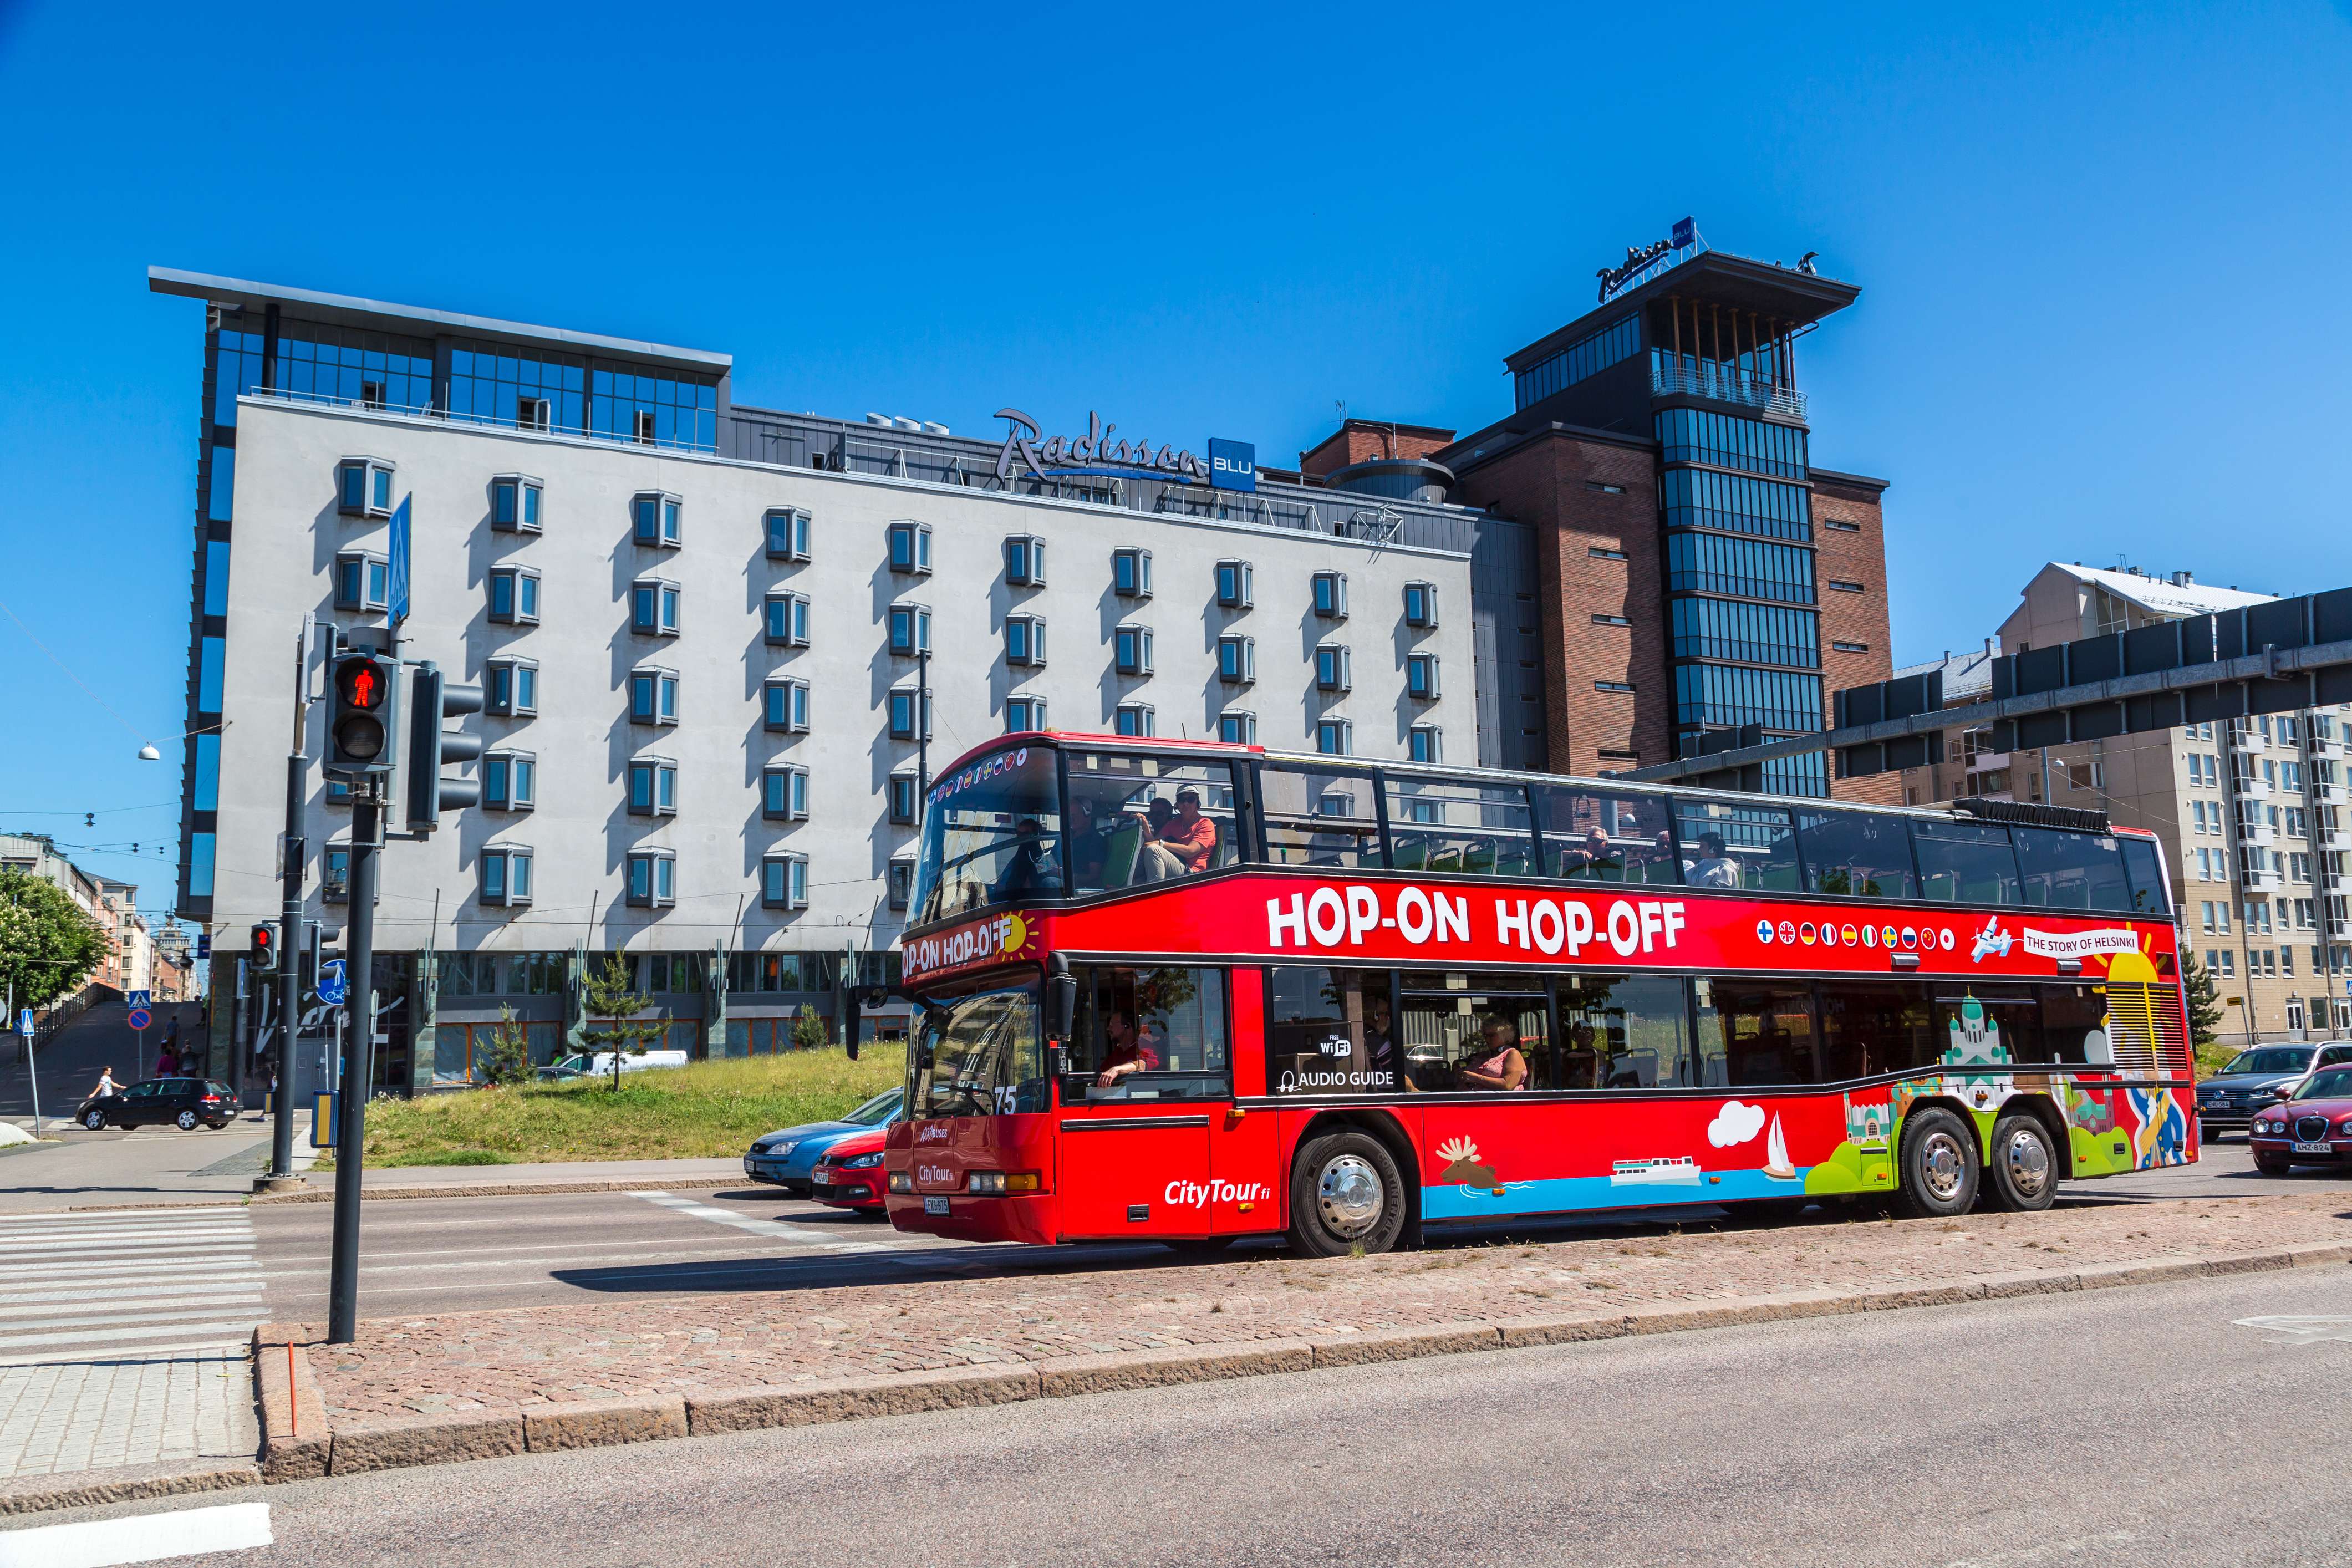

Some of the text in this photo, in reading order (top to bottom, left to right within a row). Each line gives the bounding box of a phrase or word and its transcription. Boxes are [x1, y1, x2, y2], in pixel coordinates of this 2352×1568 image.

[1674, 226, 1690, 241] BLU
[993, 408, 1206, 484] Radisson
[1214, 457, 1251, 475] BLU
[1267, 886, 1686, 956] HOP-ON HOP-OFF
[902, 918, 1012, 978] OP-ON HOP-OFF
[2027, 936, 2135, 952] THE STORY OF HELSINKI
[1298, 1071, 1394, 1086] AUDIO GUIDE
[995, 1086, 1016, 1115] 75
[933, 1129, 947, 1138] BUSES
[1377, 1152, 1399, 1233] CONTINENTAL
